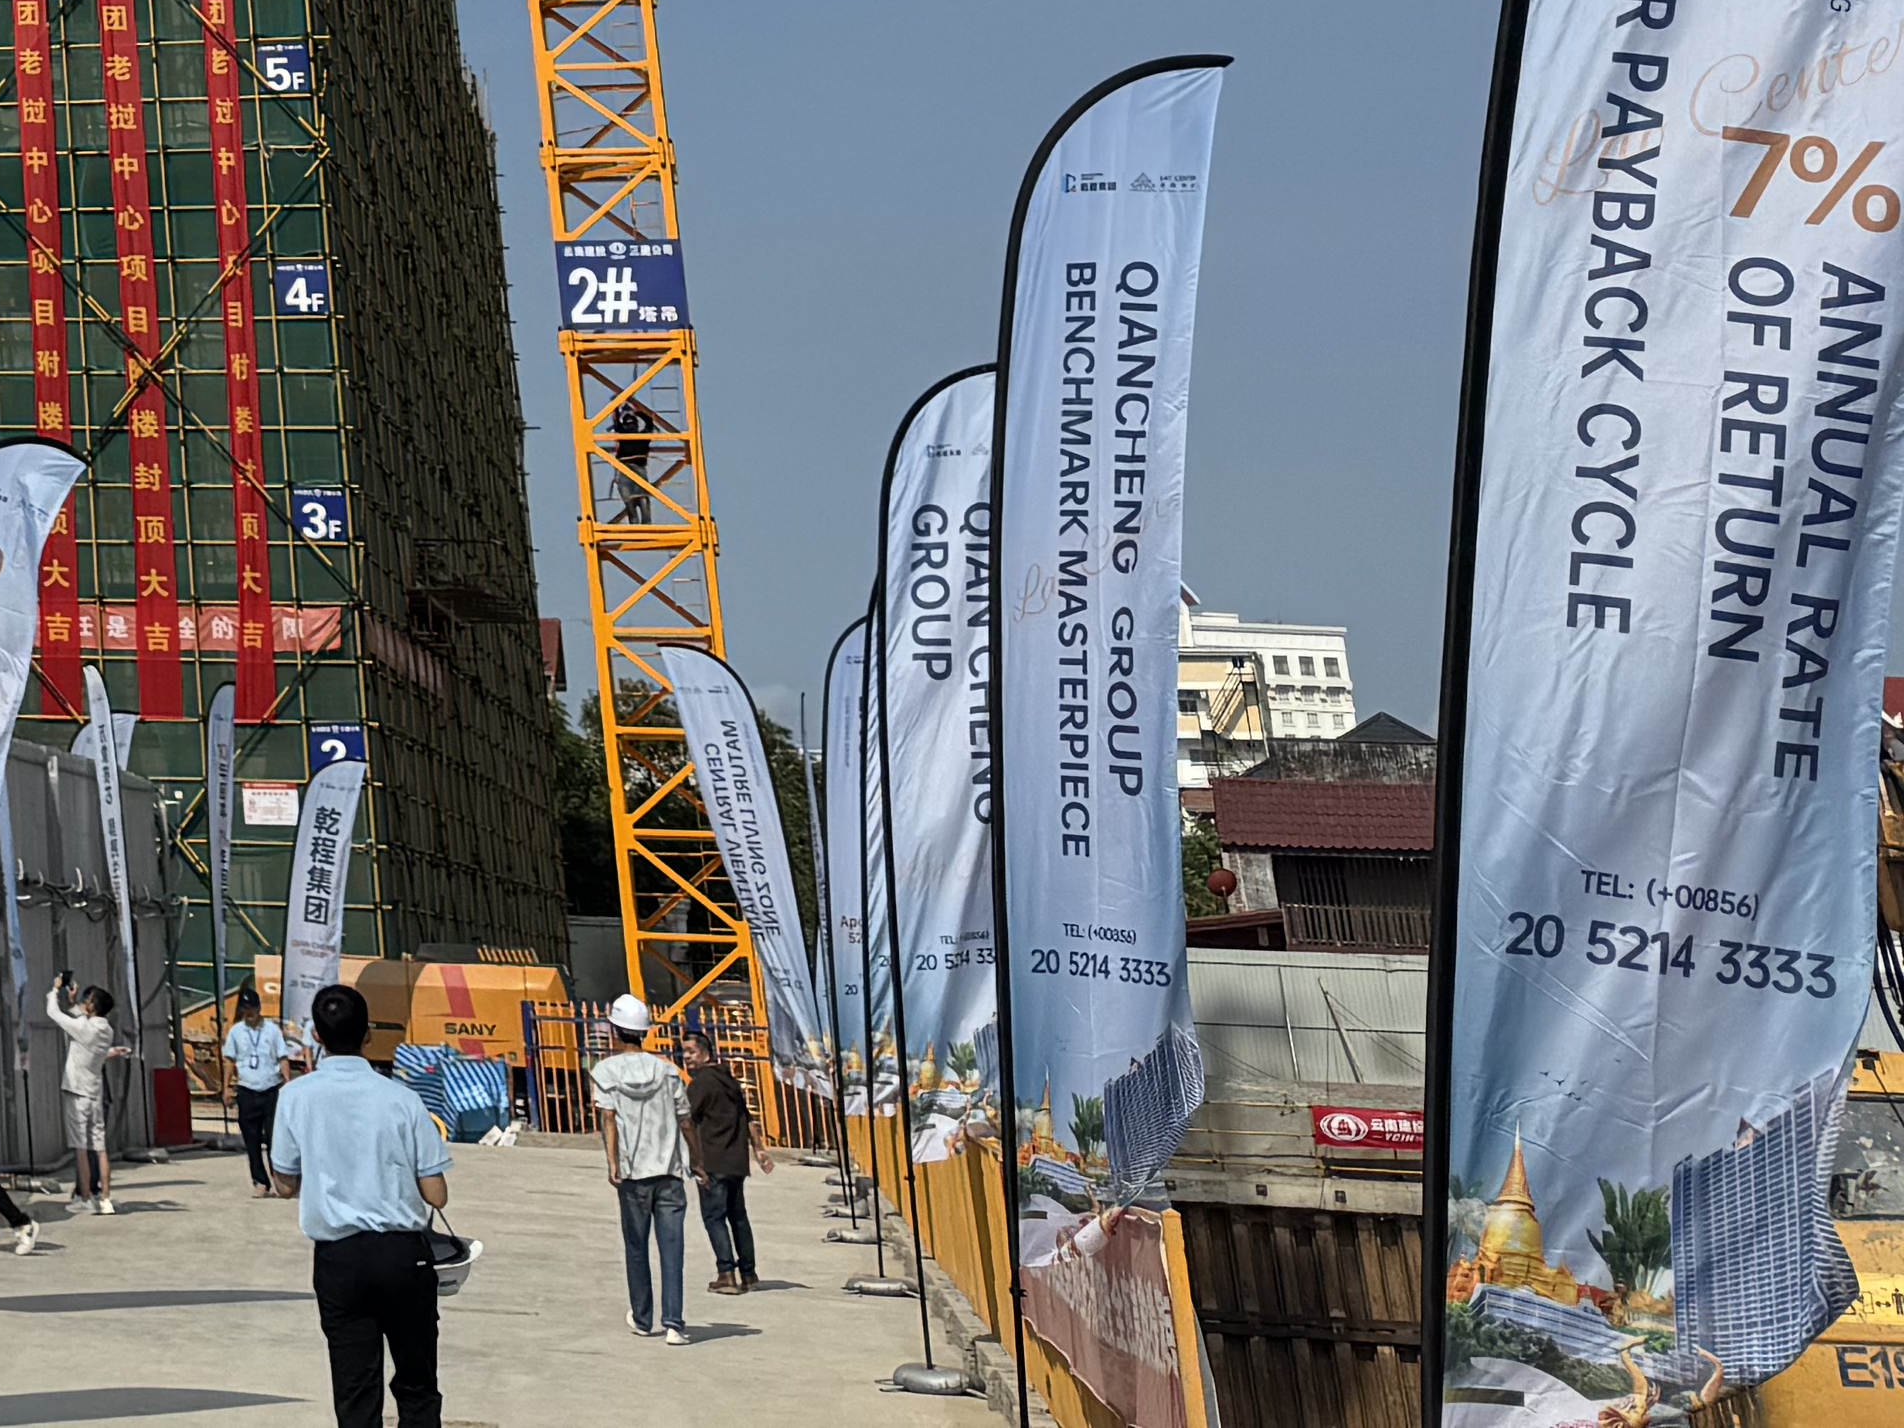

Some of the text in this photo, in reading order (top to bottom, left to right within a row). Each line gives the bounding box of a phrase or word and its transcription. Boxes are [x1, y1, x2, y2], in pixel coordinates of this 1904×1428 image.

[265, 58, 305, 92] 5F
[1581, 52, 1669, 382] PAYBACK
[1721, 124, 1902, 236] 7%
[284, 276, 325, 312] 4F
[568, 266, 679, 323] 2# 塔吊
[1708, 256, 1793, 663] OF RETURN
[301, 502, 342, 540] 3F
[1057, 261, 1098, 858] BENCHMARK MASTERPIECE
[1106, 260, 1160, 798] QIANCHENG GROUP
[1567, 402, 1642, 635] CYCLE
[1772, 261, 1886, 783] ANNUAL RATE
[910, 502, 953, 681] GROUP
[303, 805, 342, 926] 乾程集团
[1581, 869, 1760, 921] TEL: (+00856)
[917, 951, 938, 971] 20
[1031, 949, 1172, 988] 20 5214 3333
[1506, 911, 1837, 999] 20 5214 3333
[445, 1022, 497, 1036] SANY
